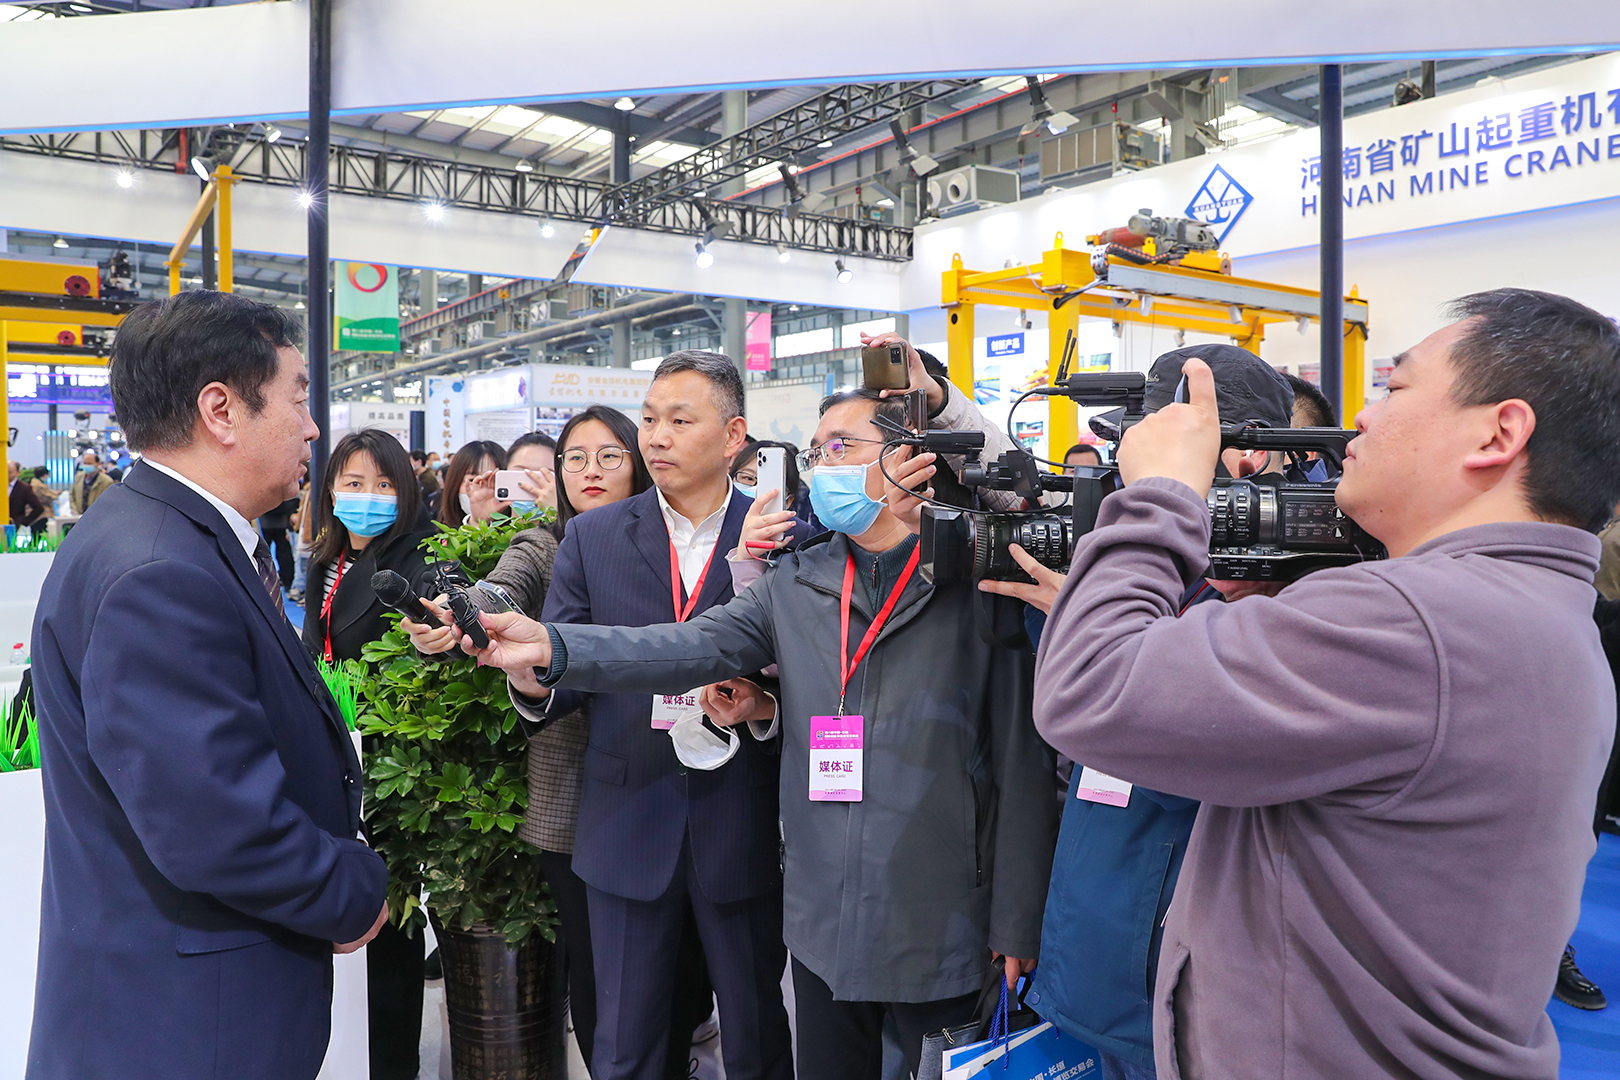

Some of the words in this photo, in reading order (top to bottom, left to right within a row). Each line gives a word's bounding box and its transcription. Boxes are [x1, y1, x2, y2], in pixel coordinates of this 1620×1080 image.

[1410, 160, 1489, 198] MINE
[662, 695, 696, 707] 媒体证
[819, 760, 853, 773] 媒体证
